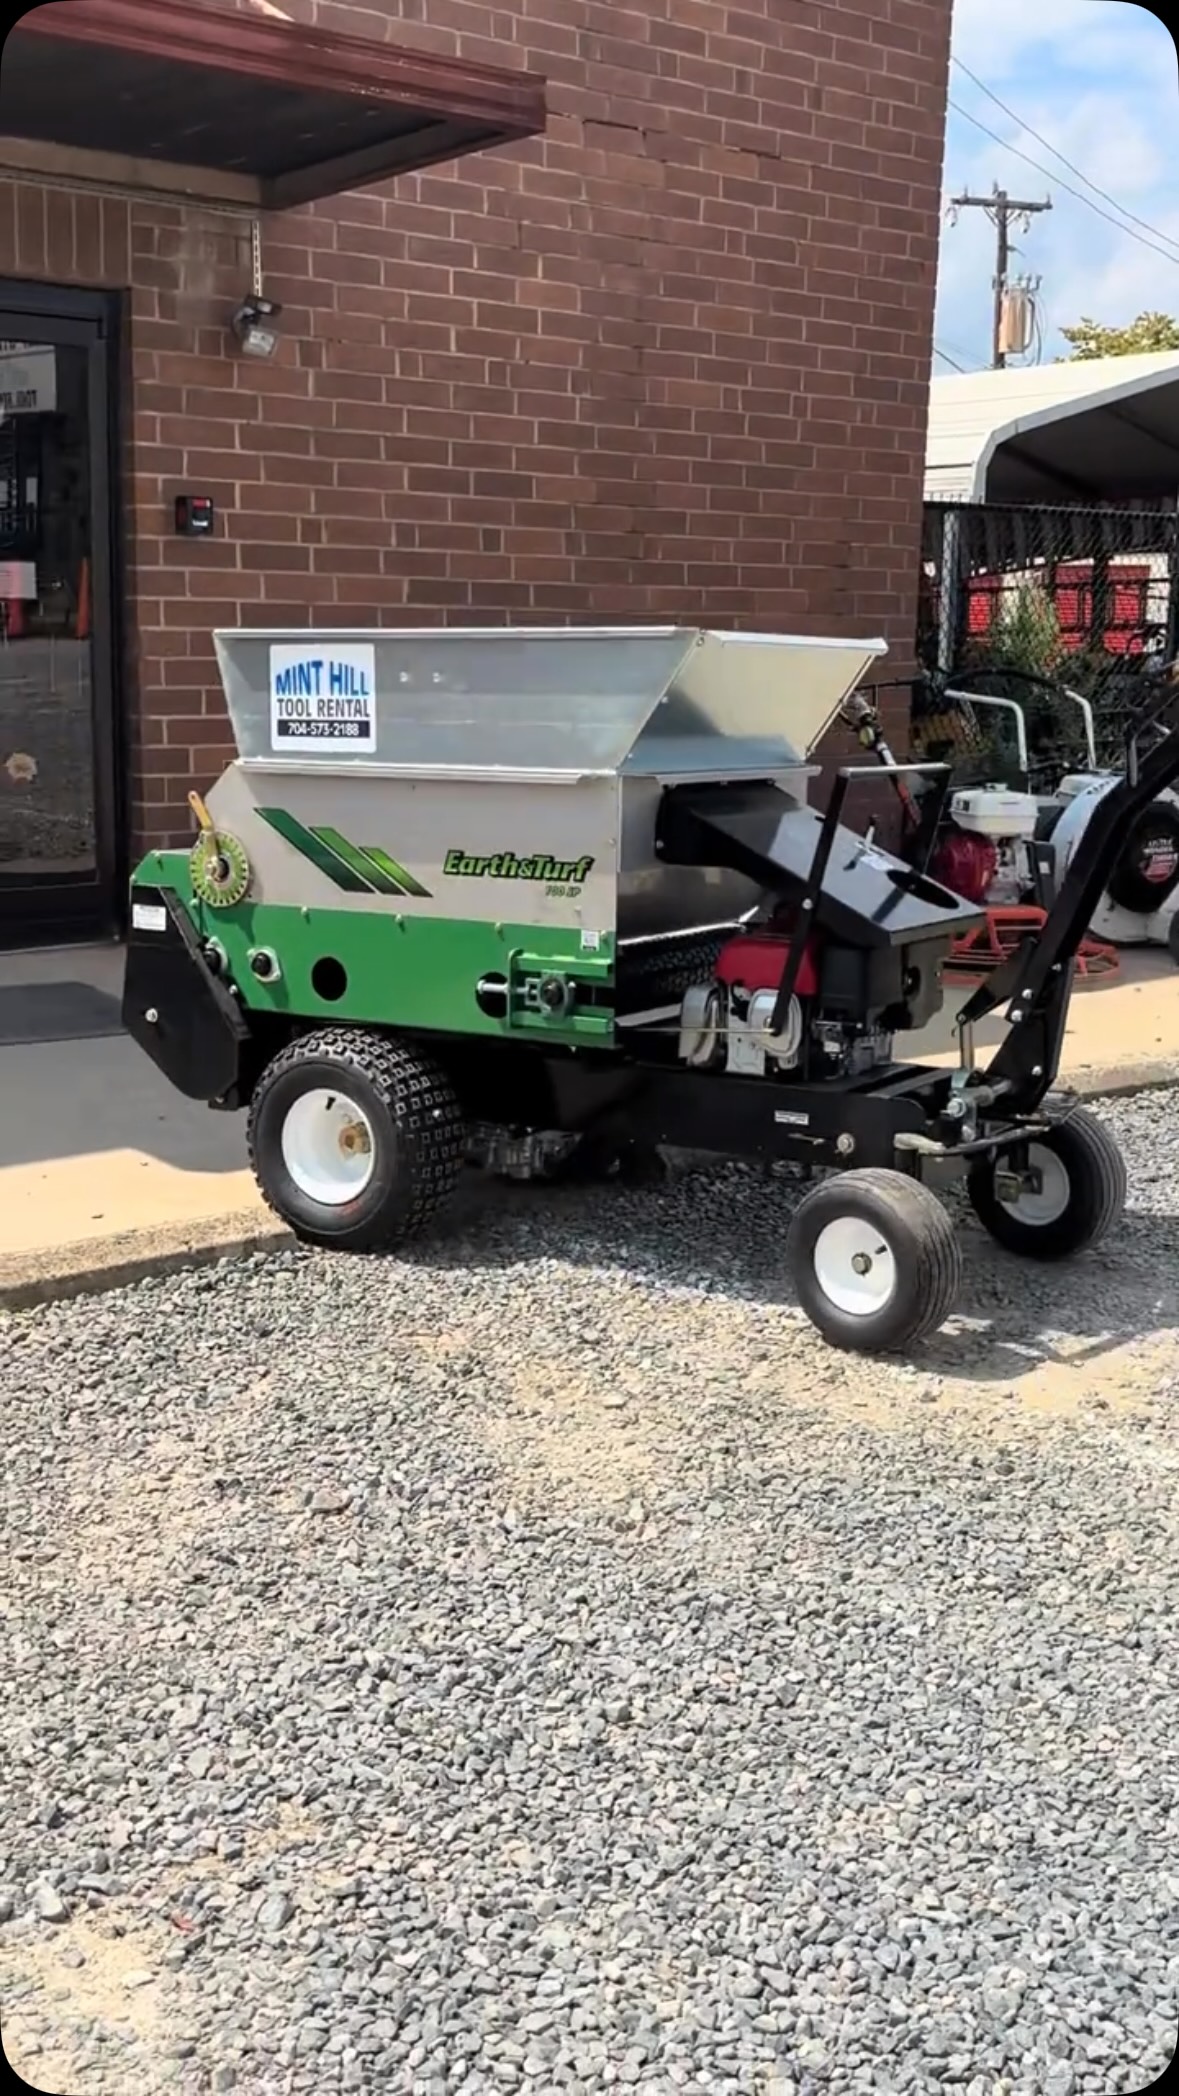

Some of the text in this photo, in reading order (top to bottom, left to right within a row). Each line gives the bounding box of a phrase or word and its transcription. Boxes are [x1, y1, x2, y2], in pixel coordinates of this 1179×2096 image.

[276, 661, 370, 695] MINT HILL
[276, 699, 371, 718] TOOL RENTAL
[287, 722, 360, 737] 704-573-2188
[444, 849, 595, 882] Earth&Turf
